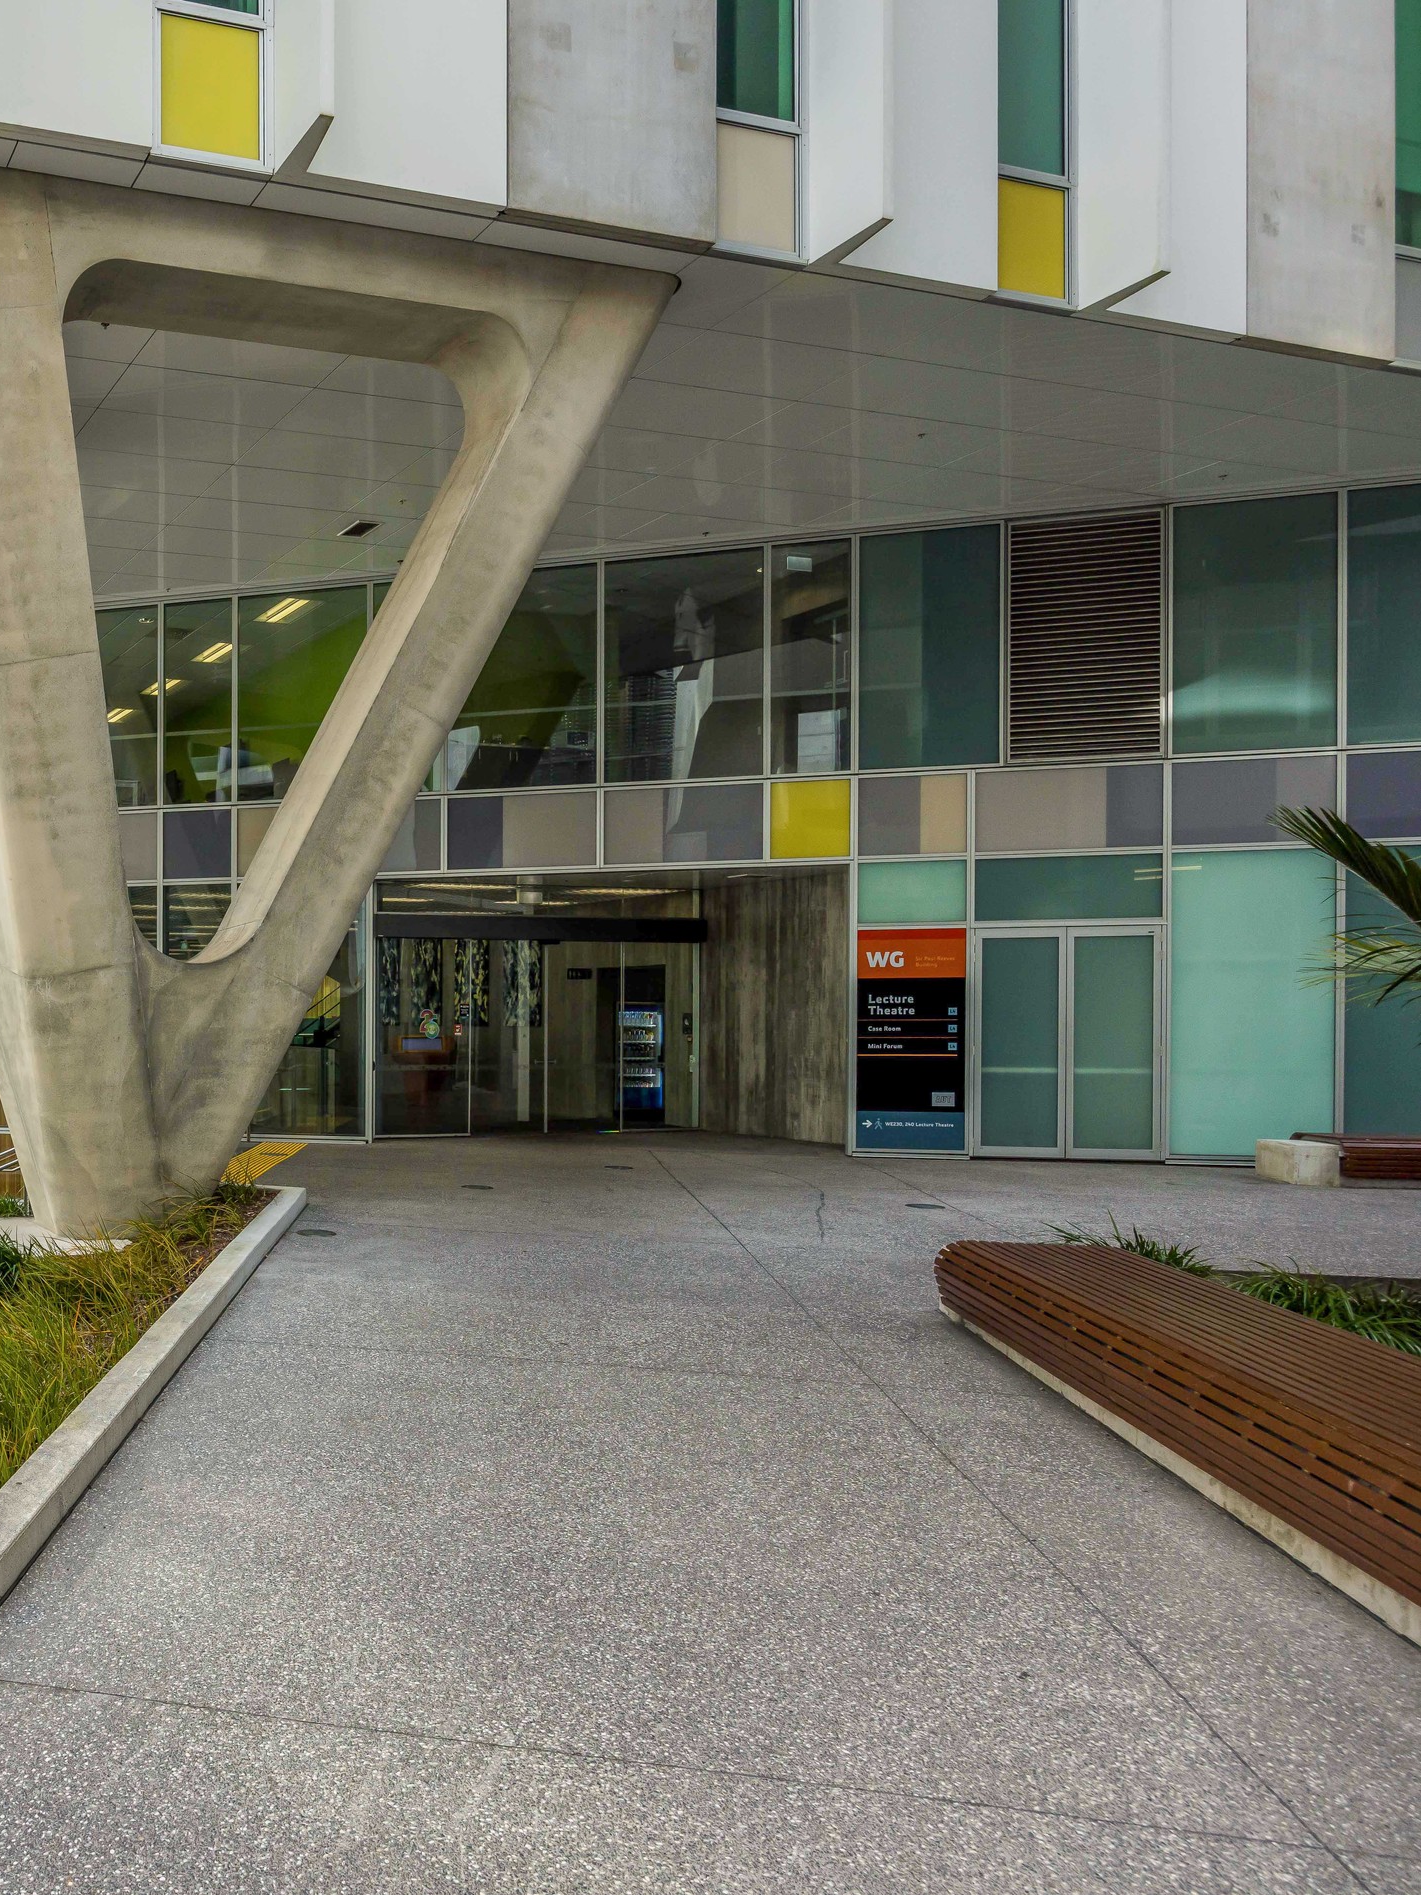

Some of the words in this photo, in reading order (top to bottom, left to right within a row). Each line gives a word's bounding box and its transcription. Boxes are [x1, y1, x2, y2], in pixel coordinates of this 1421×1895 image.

[866, 951, 905, 968] WG
[868, 994, 914, 1004] Lecture
[867, 1005, 915, 1015] Theatre
